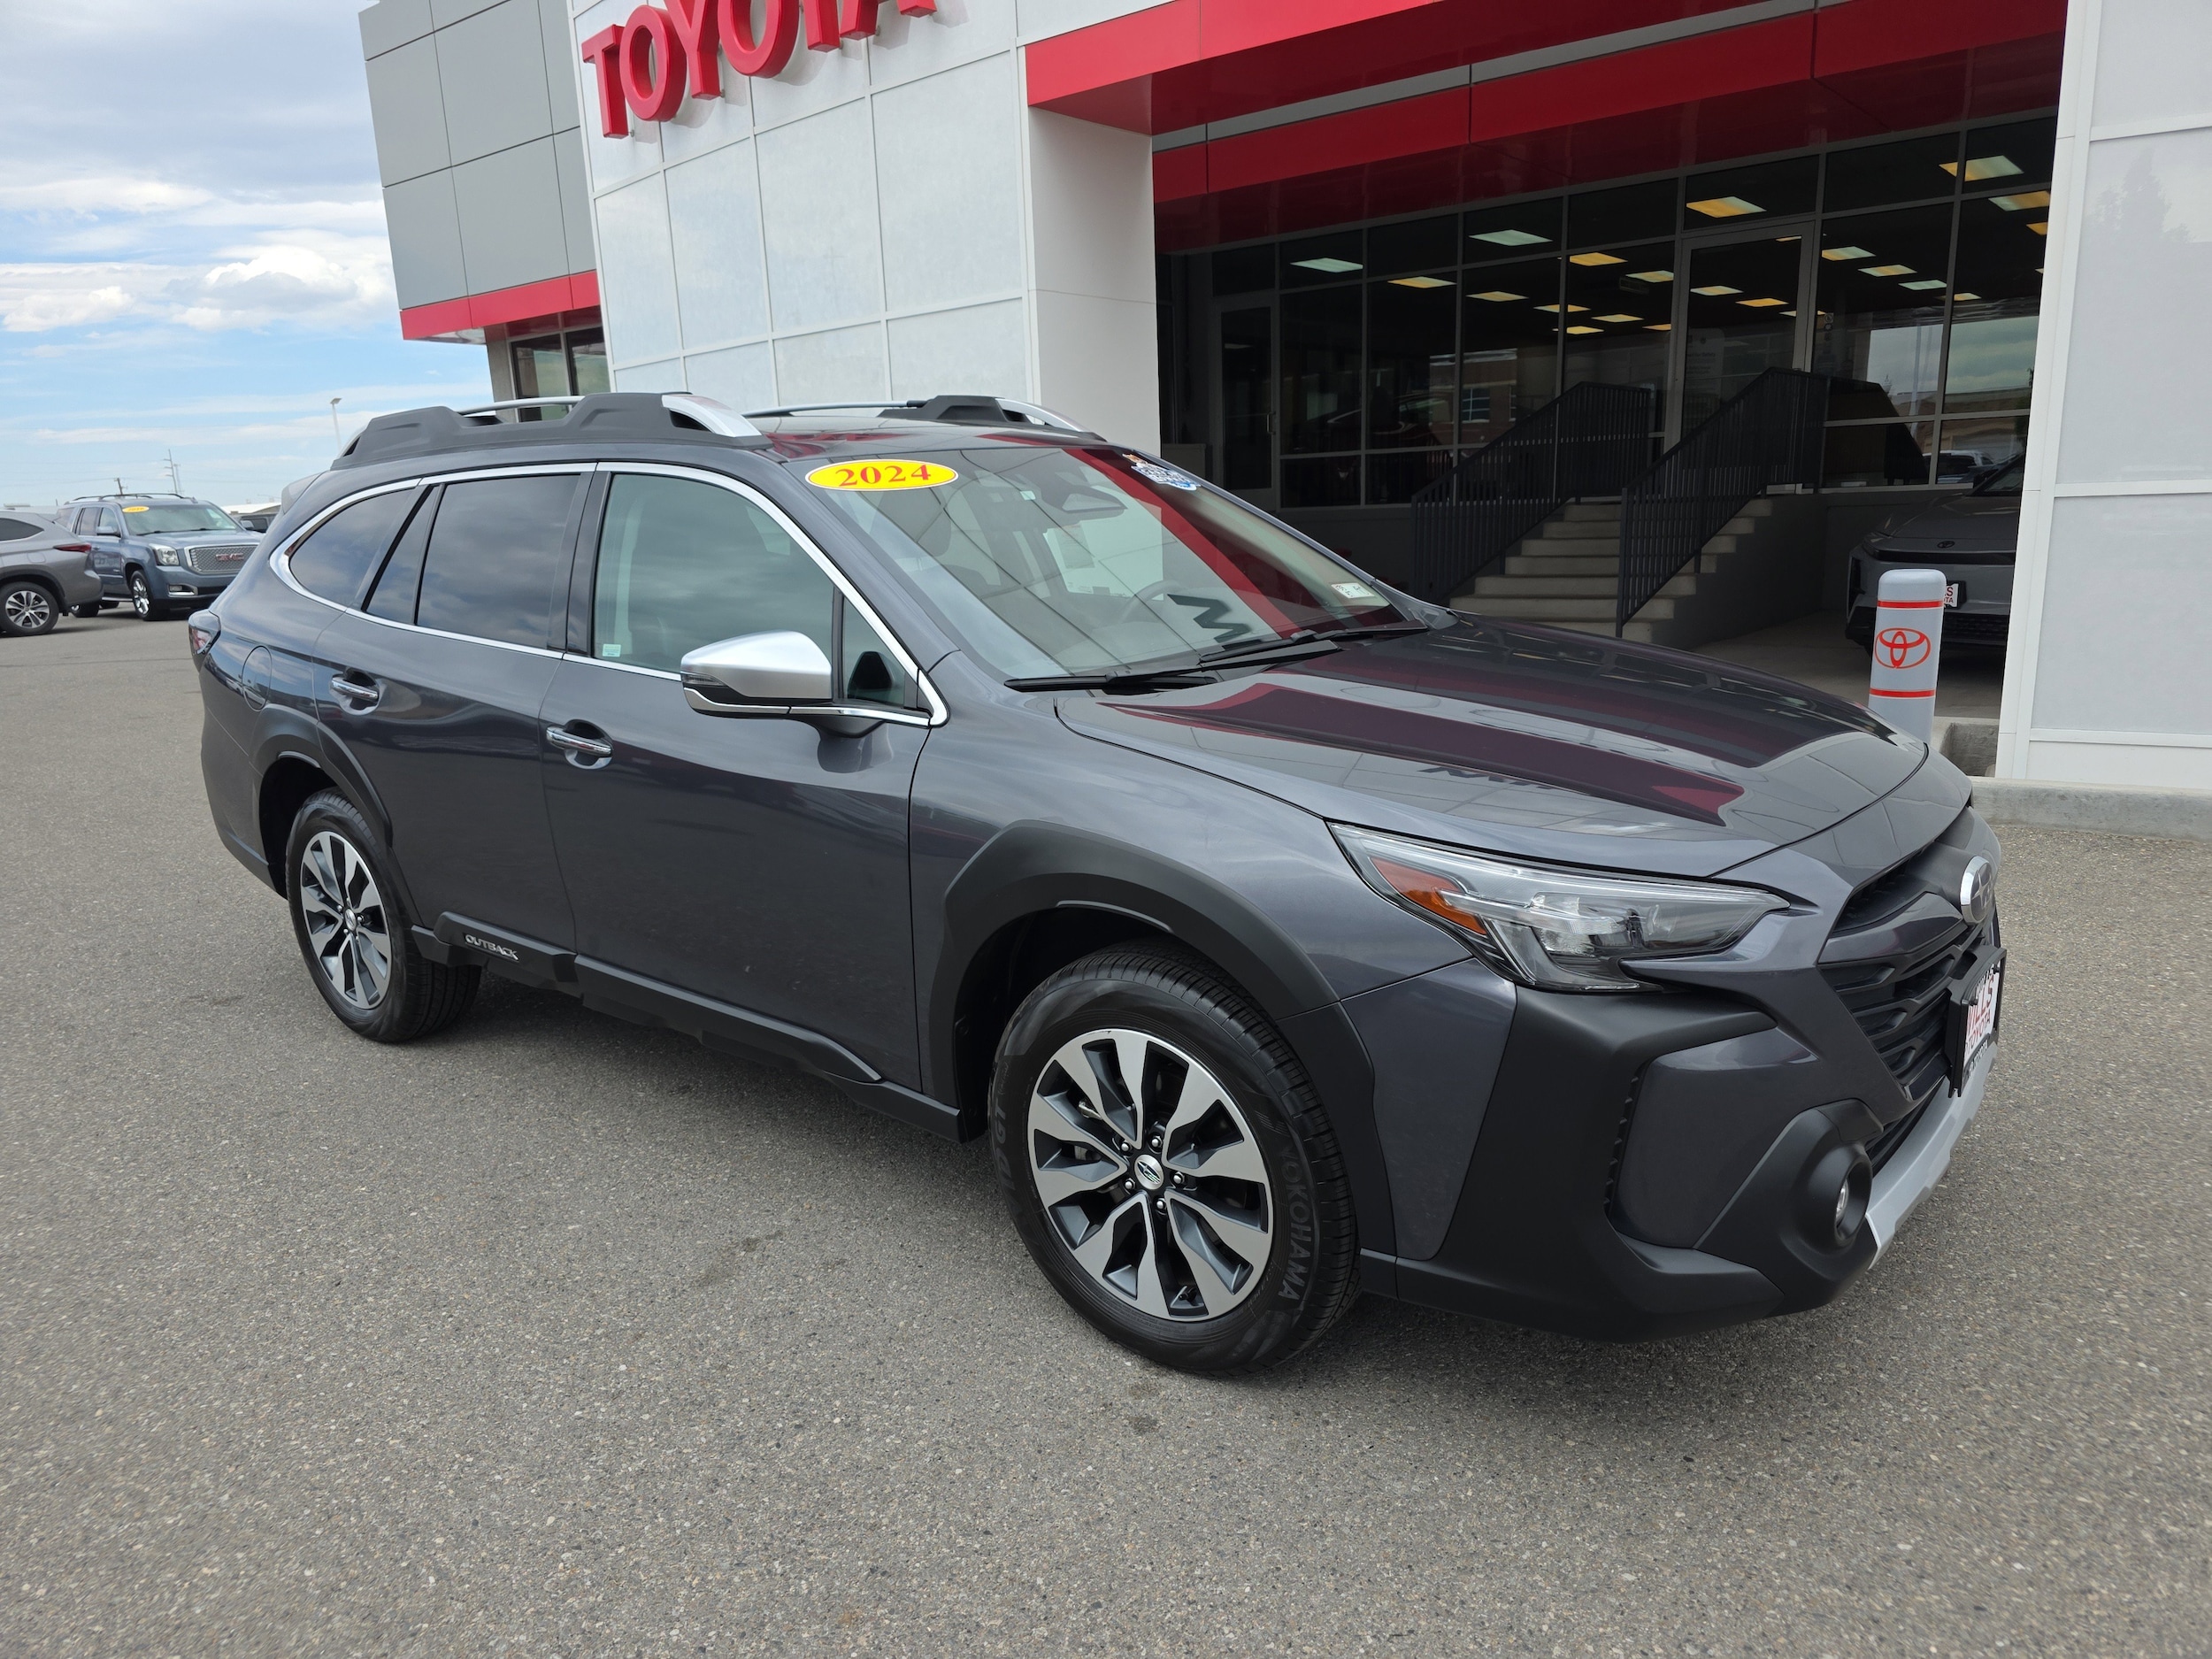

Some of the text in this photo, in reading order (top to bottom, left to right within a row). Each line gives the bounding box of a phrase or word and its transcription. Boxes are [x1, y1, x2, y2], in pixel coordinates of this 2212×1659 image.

[835, 464, 931, 488] 2024
[465, 934, 519, 961] OUTBACK
[995, 1095, 1007, 1145] GT
[1278, 1147, 1312, 1300] YOKOHAMA
